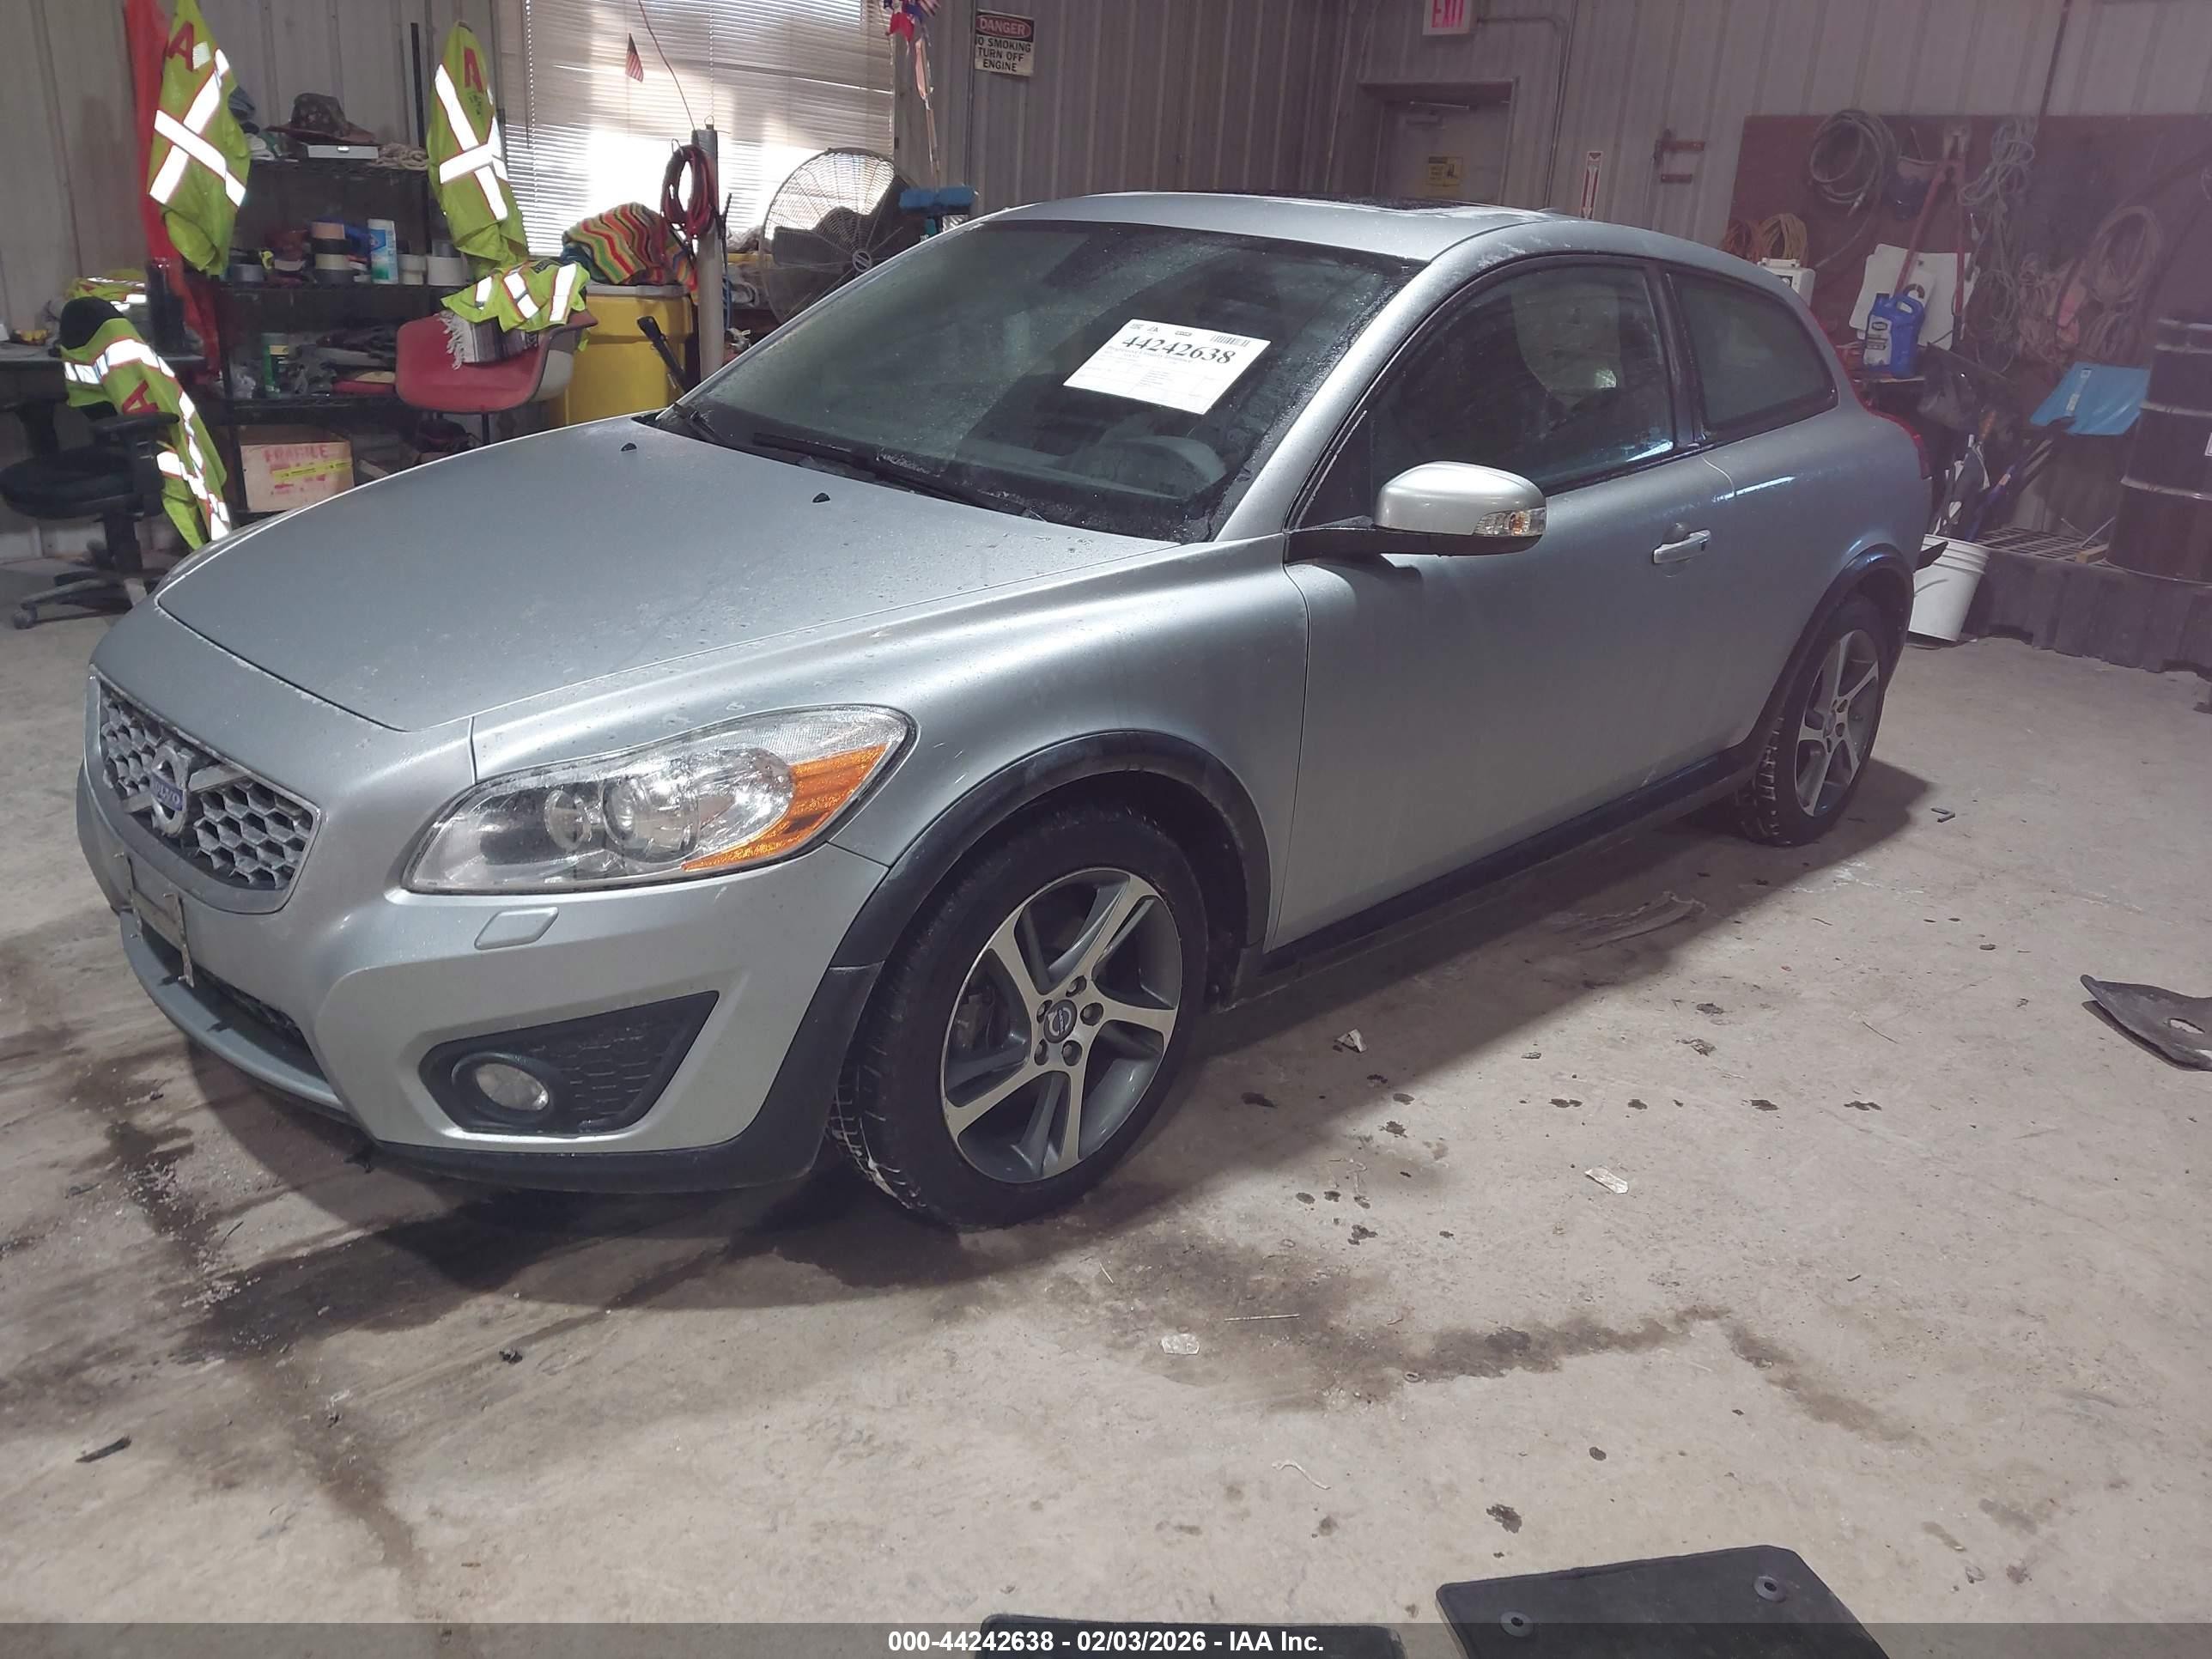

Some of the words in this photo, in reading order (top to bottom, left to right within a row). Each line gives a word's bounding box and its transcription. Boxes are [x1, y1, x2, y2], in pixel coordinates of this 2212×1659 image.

[980, 17, 1025, 35] DANGER
[988, 37, 1031, 52] SMOKING
[978, 46, 1003, 58] TURN
[1006, 52, 1024, 62] OFF
[983, 58, 1017, 72] ENGINE
[1121, 336, 1236, 364] 44242638
